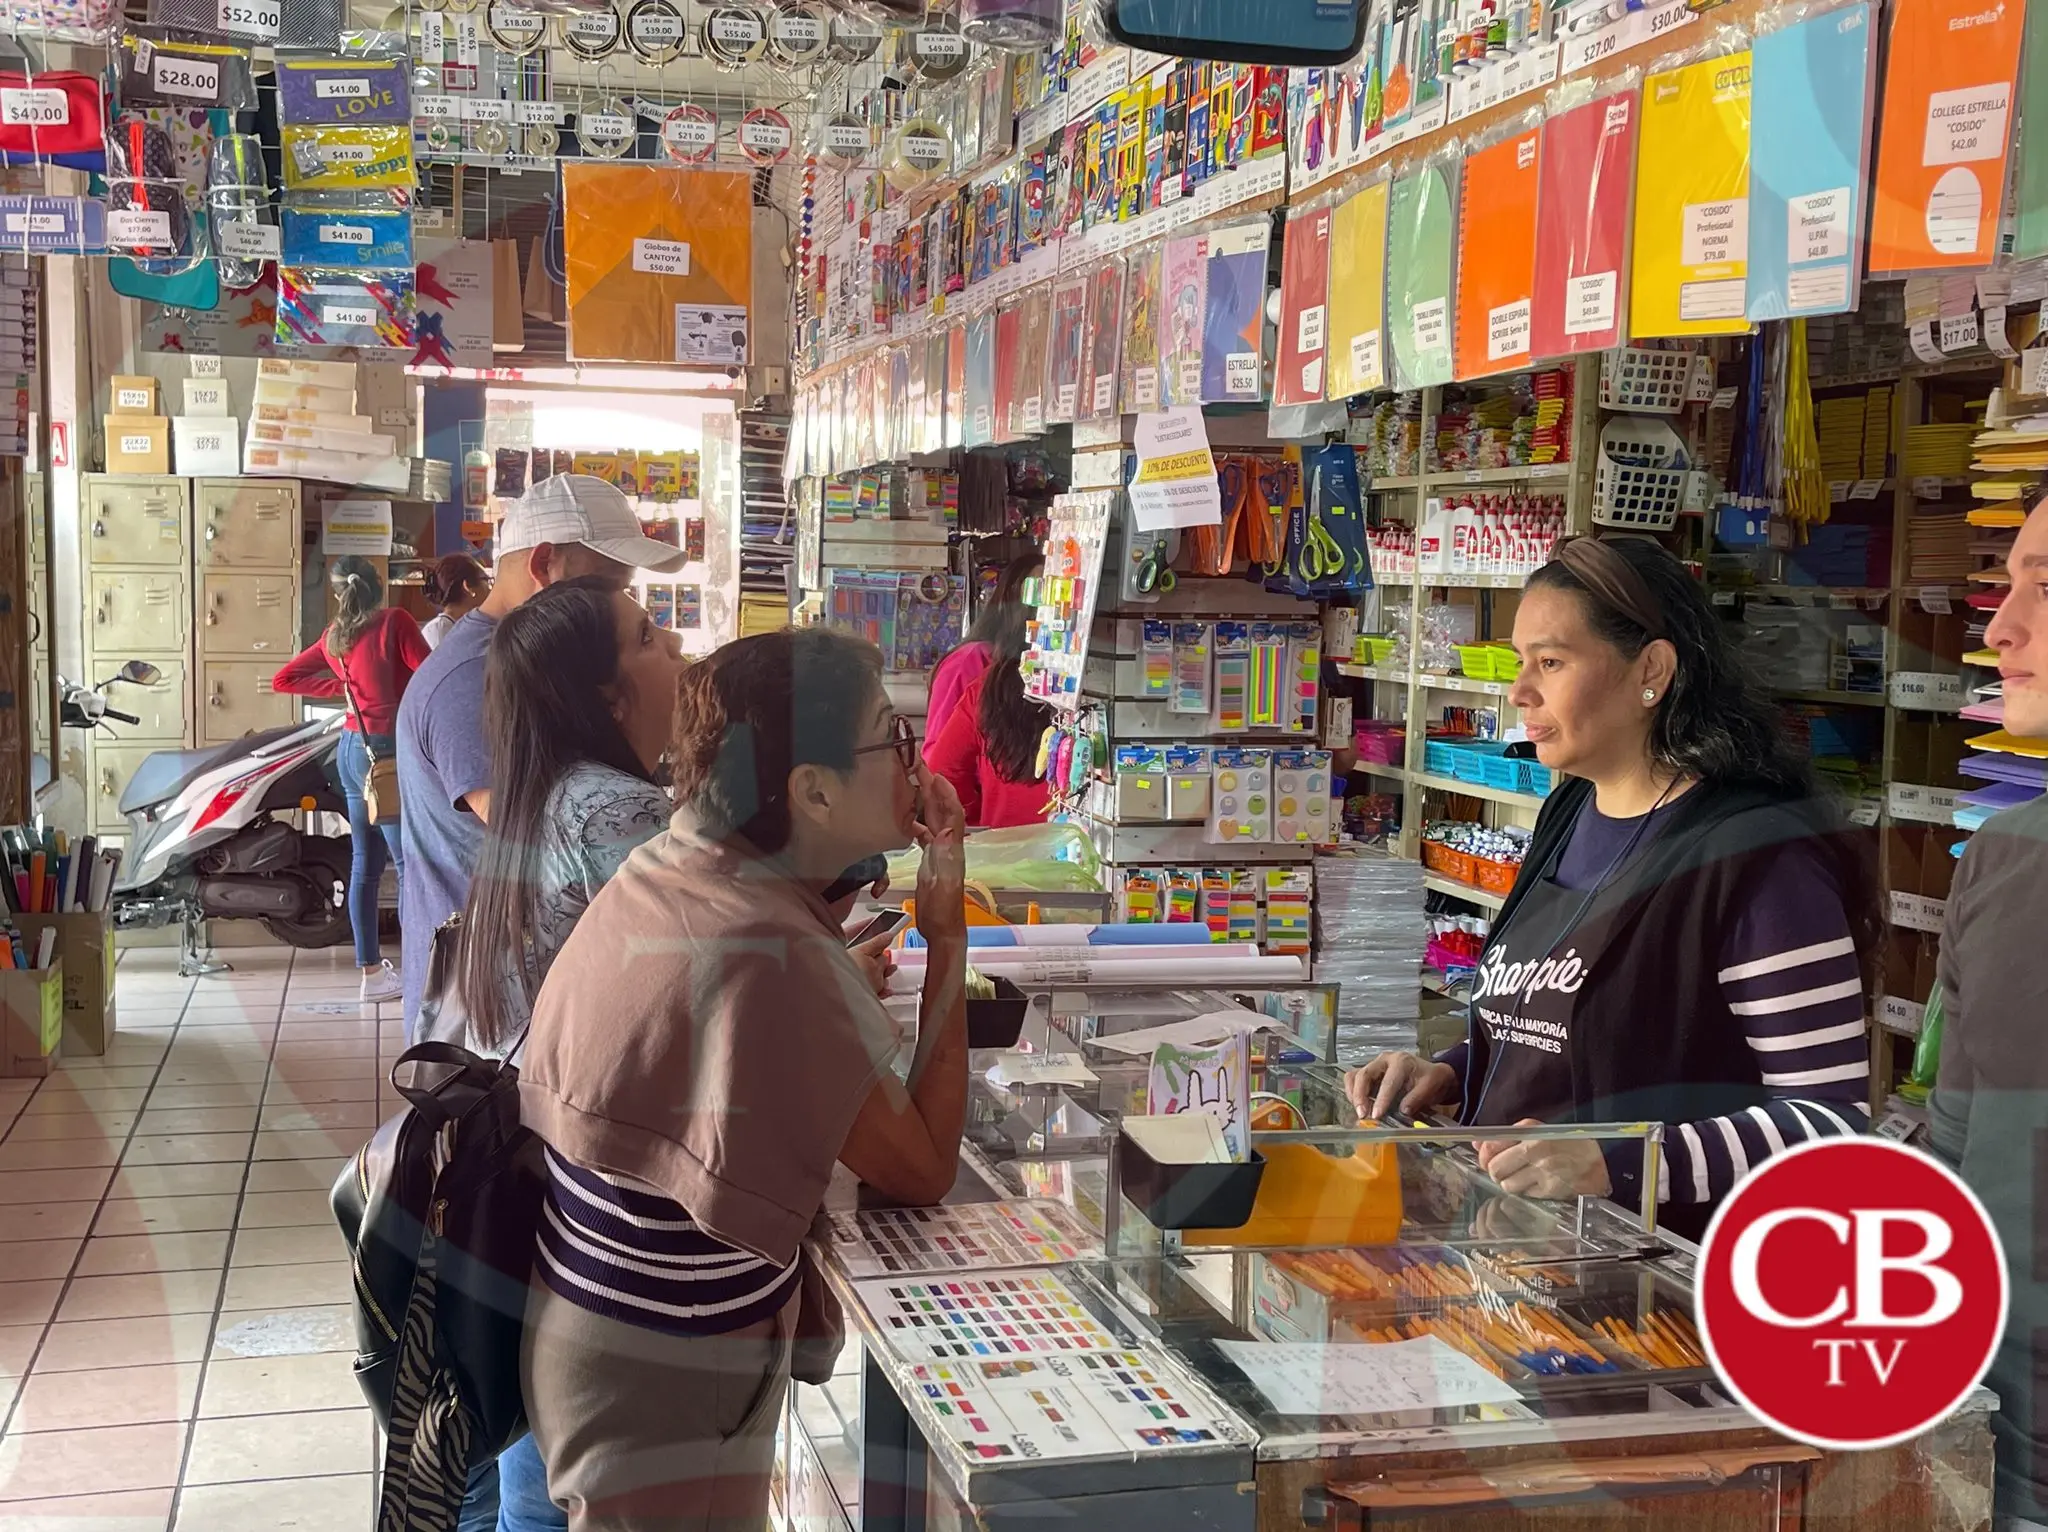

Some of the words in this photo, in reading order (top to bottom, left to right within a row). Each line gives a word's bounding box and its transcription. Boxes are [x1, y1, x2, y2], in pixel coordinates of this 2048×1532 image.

[221, 6, 279, 28] $52.00
[1650, 4, 1687, 33] $30.00
[1948, 14, 2000, 31] Estrella
[504, 18, 532, 29] $18.00
[578, 22, 607, 33] $30.00
[645, 26, 672, 35] $39.00
[723, 29, 751, 39] $55.00
[788, 28, 815, 38] $78.00
[433, 25, 441, 49] $7.00
[467, 27, 476, 52] $9.00
[928, 44, 954, 53] $49.00
[1583, 35, 1616, 63] $27.00
[158, 68, 218, 90] $28.00
[328, 84, 361, 95] $41.00
[335, 89, 395, 119] LOVE
[424, 105, 448, 114] $2.00
[1967, 96, 2007, 113] ESTRELLA
[476, 110, 499, 119] $7.00
[526, 112, 555, 122] $12.00
[593, 126, 622, 136] $14.00
[677, 131, 705, 141] $21.00
[753, 135, 780, 145] $28.00
[834, 136, 862, 145] $18.00
[1951, 136, 1978, 151] $42.00
[332, 150, 364, 160] $41.00
[912, 147, 938, 156] $49.00
[353, 153, 409, 179] Happy
[331, 230, 363, 241] $41.00
[1701, 236, 1728, 247] NORMA
[644, 242, 670, 253] Globos
[671, 245, 681, 253] de
[643, 253, 682, 264] CANTOYA
[649, 264, 675, 273] $50.00
[335, 312, 367, 324] $41.00
[1943, 327, 1976, 346] $17.00
[1228, 359, 1257, 372] ESTRELLA
[1160, 459, 1170, 471] DE
[1170, 453, 1208, 470] DESCUENTO
[1887, 1003, 1907, 1017] $4.00
